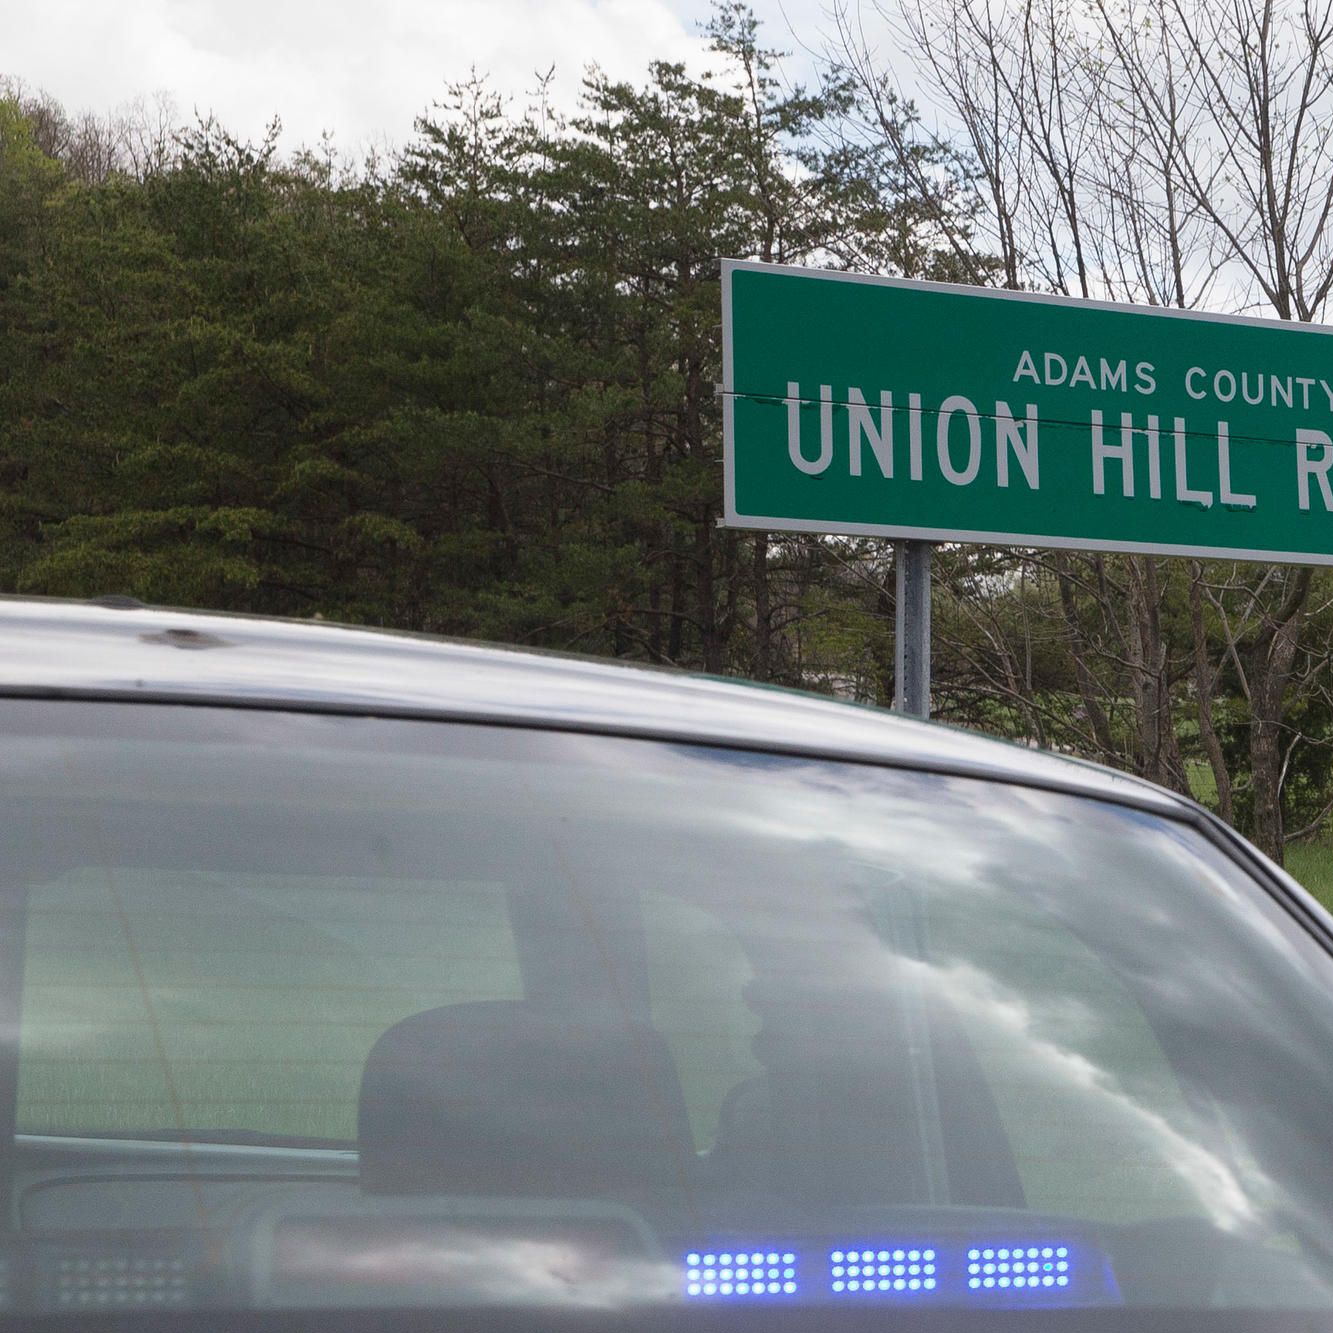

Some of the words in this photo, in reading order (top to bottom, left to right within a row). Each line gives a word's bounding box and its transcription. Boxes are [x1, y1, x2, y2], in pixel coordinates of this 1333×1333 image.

[1012, 350, 1157, 395] ADAMS
[786, 381, 1040, 490] UNION
[1091, 409, 1257, 509] HILL
